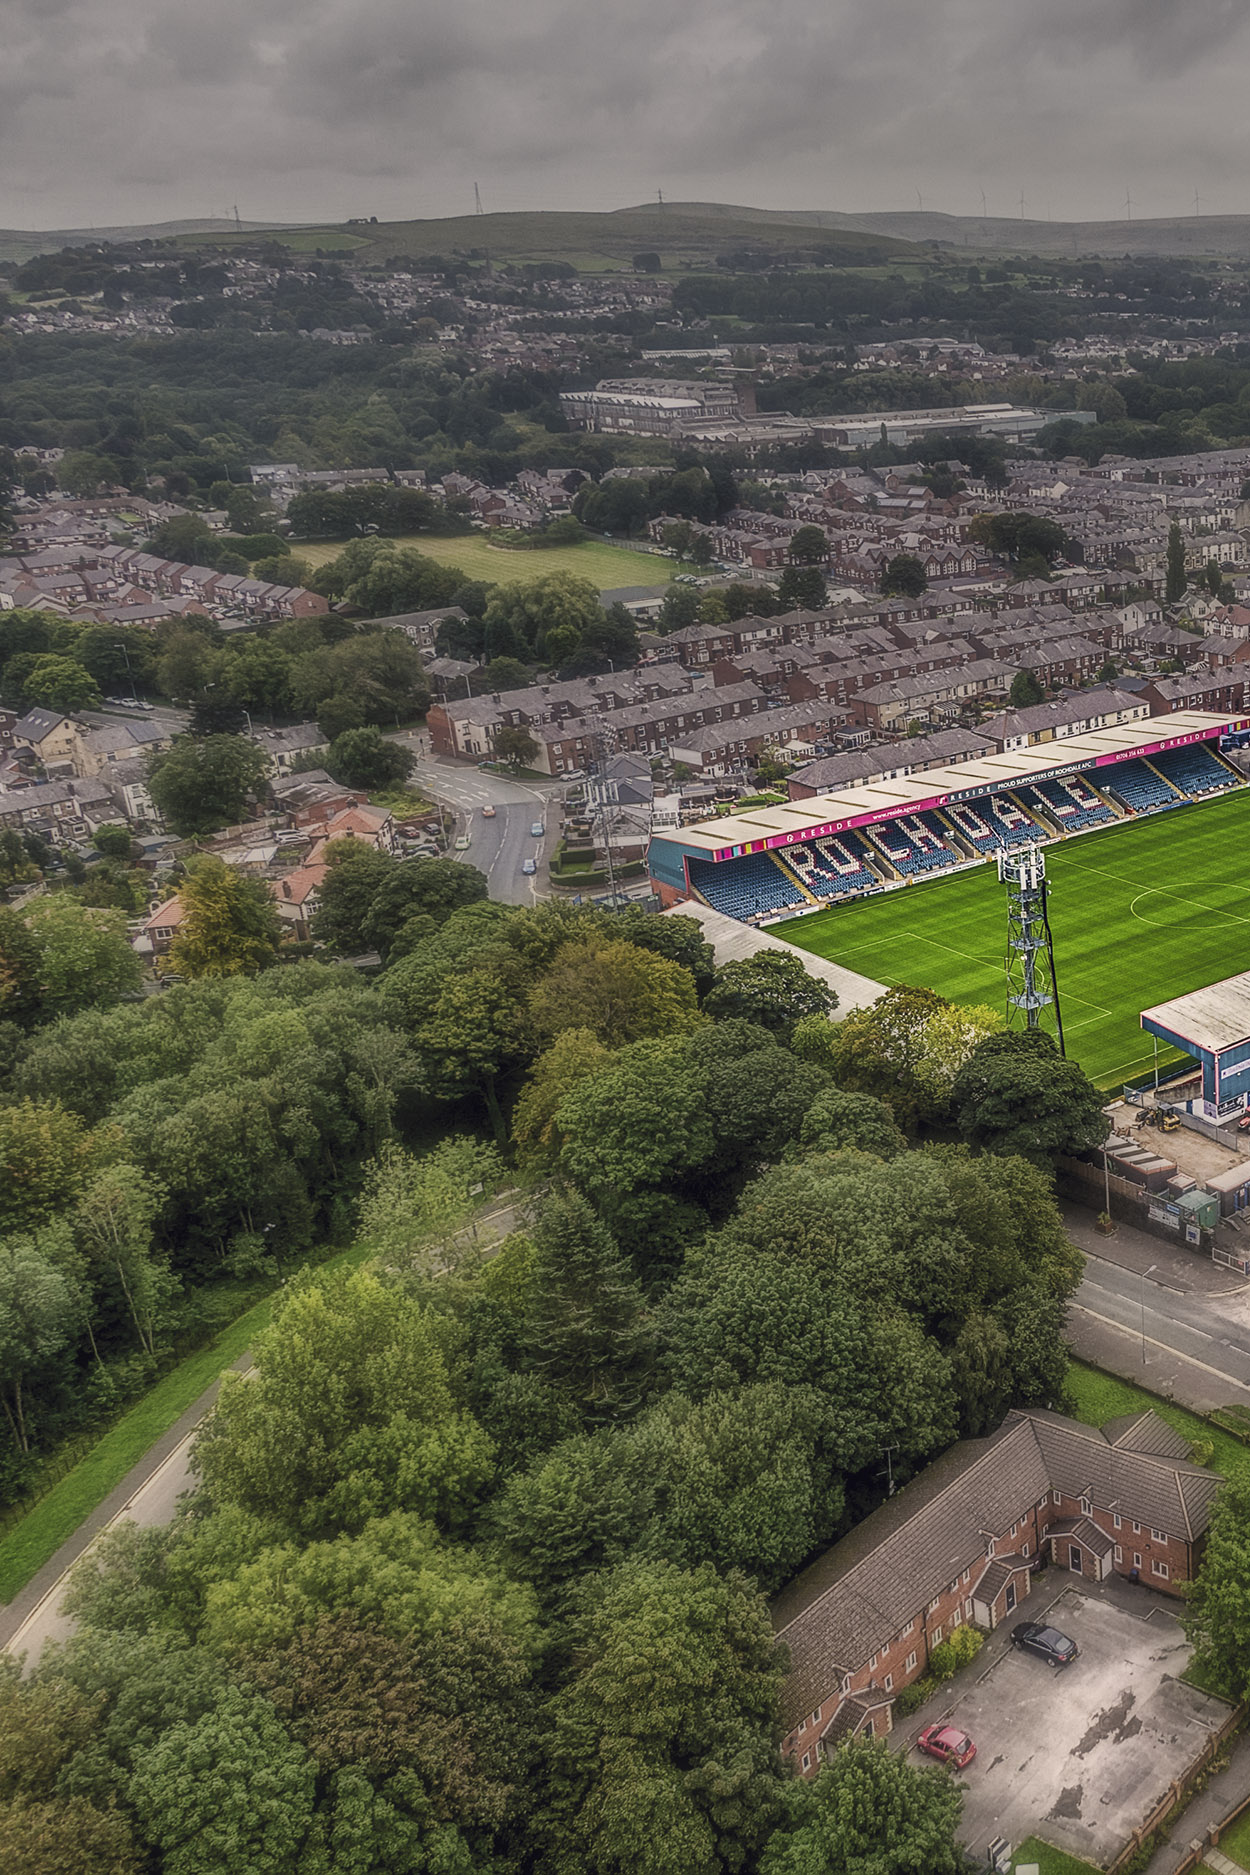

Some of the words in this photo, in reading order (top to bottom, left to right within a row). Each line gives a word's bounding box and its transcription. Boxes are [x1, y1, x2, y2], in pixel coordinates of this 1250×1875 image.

[1169, 732, 1206, 746] RESIDE
[997, 779, 1015, 790] PROUD
[1016, 772, 1047, 786] SUPPORTERS
[1047, 770, 1055, 778] OF
[1055, 764, 1081, 776] ROCHDALE
[1081, 761, 1092, 769] AFC
[950, 785, 990, 801] RESIDE
[872, 803, 921, 820] www.reside.agency
[801, 820, 852, 839] RESIDE
